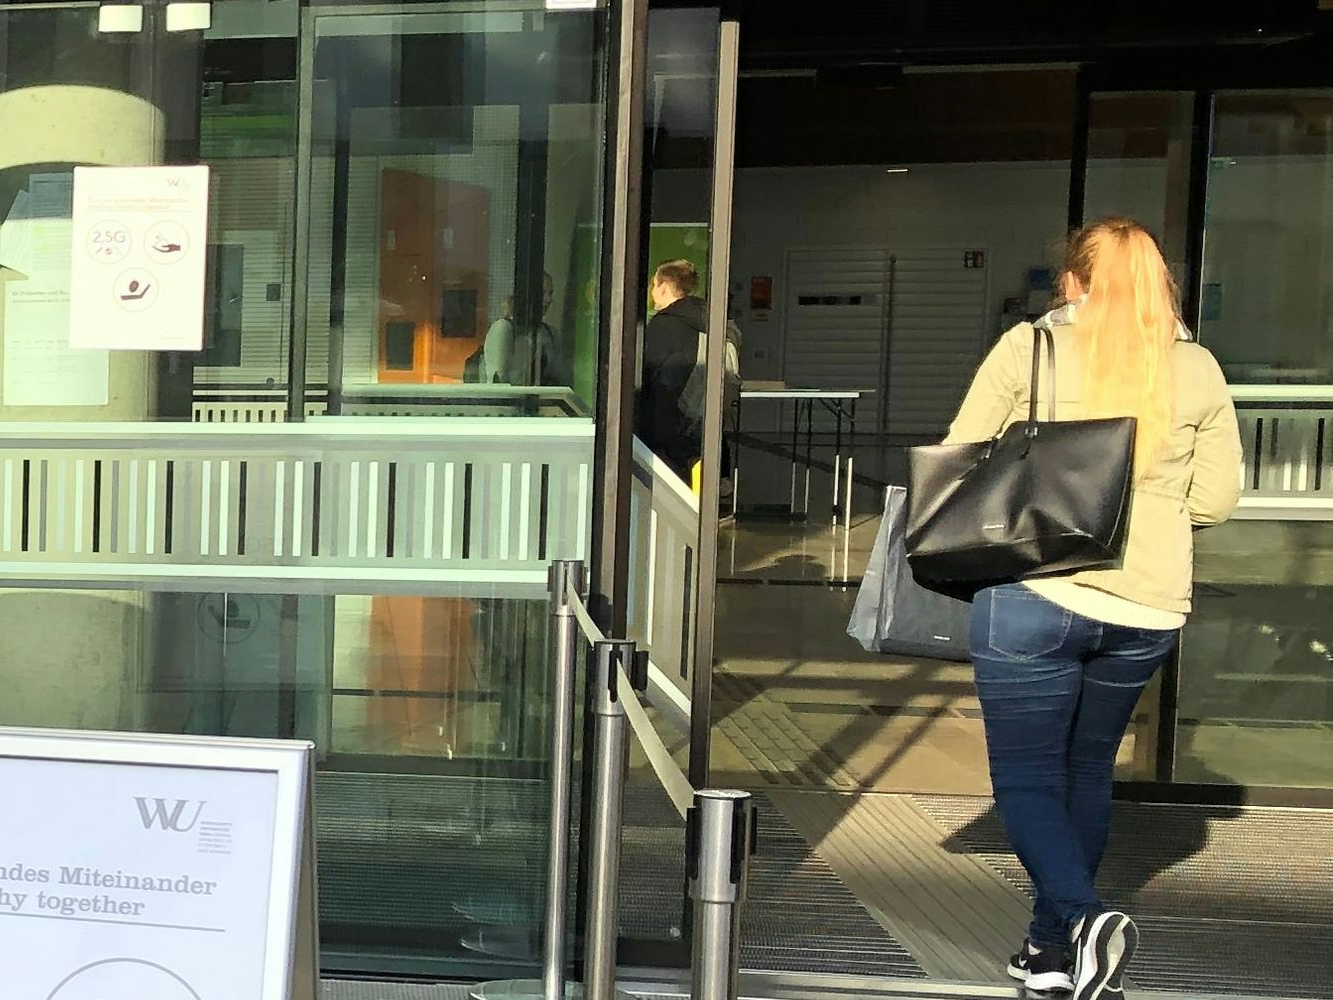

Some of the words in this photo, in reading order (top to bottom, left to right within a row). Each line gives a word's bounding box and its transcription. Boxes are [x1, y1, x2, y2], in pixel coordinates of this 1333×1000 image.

[92, 230, 126, 245] 2,5G
[133, 796, 208, 832] WU
[57, 865, 217, 896] Miteinander
[36, 889, 145, 916] together
